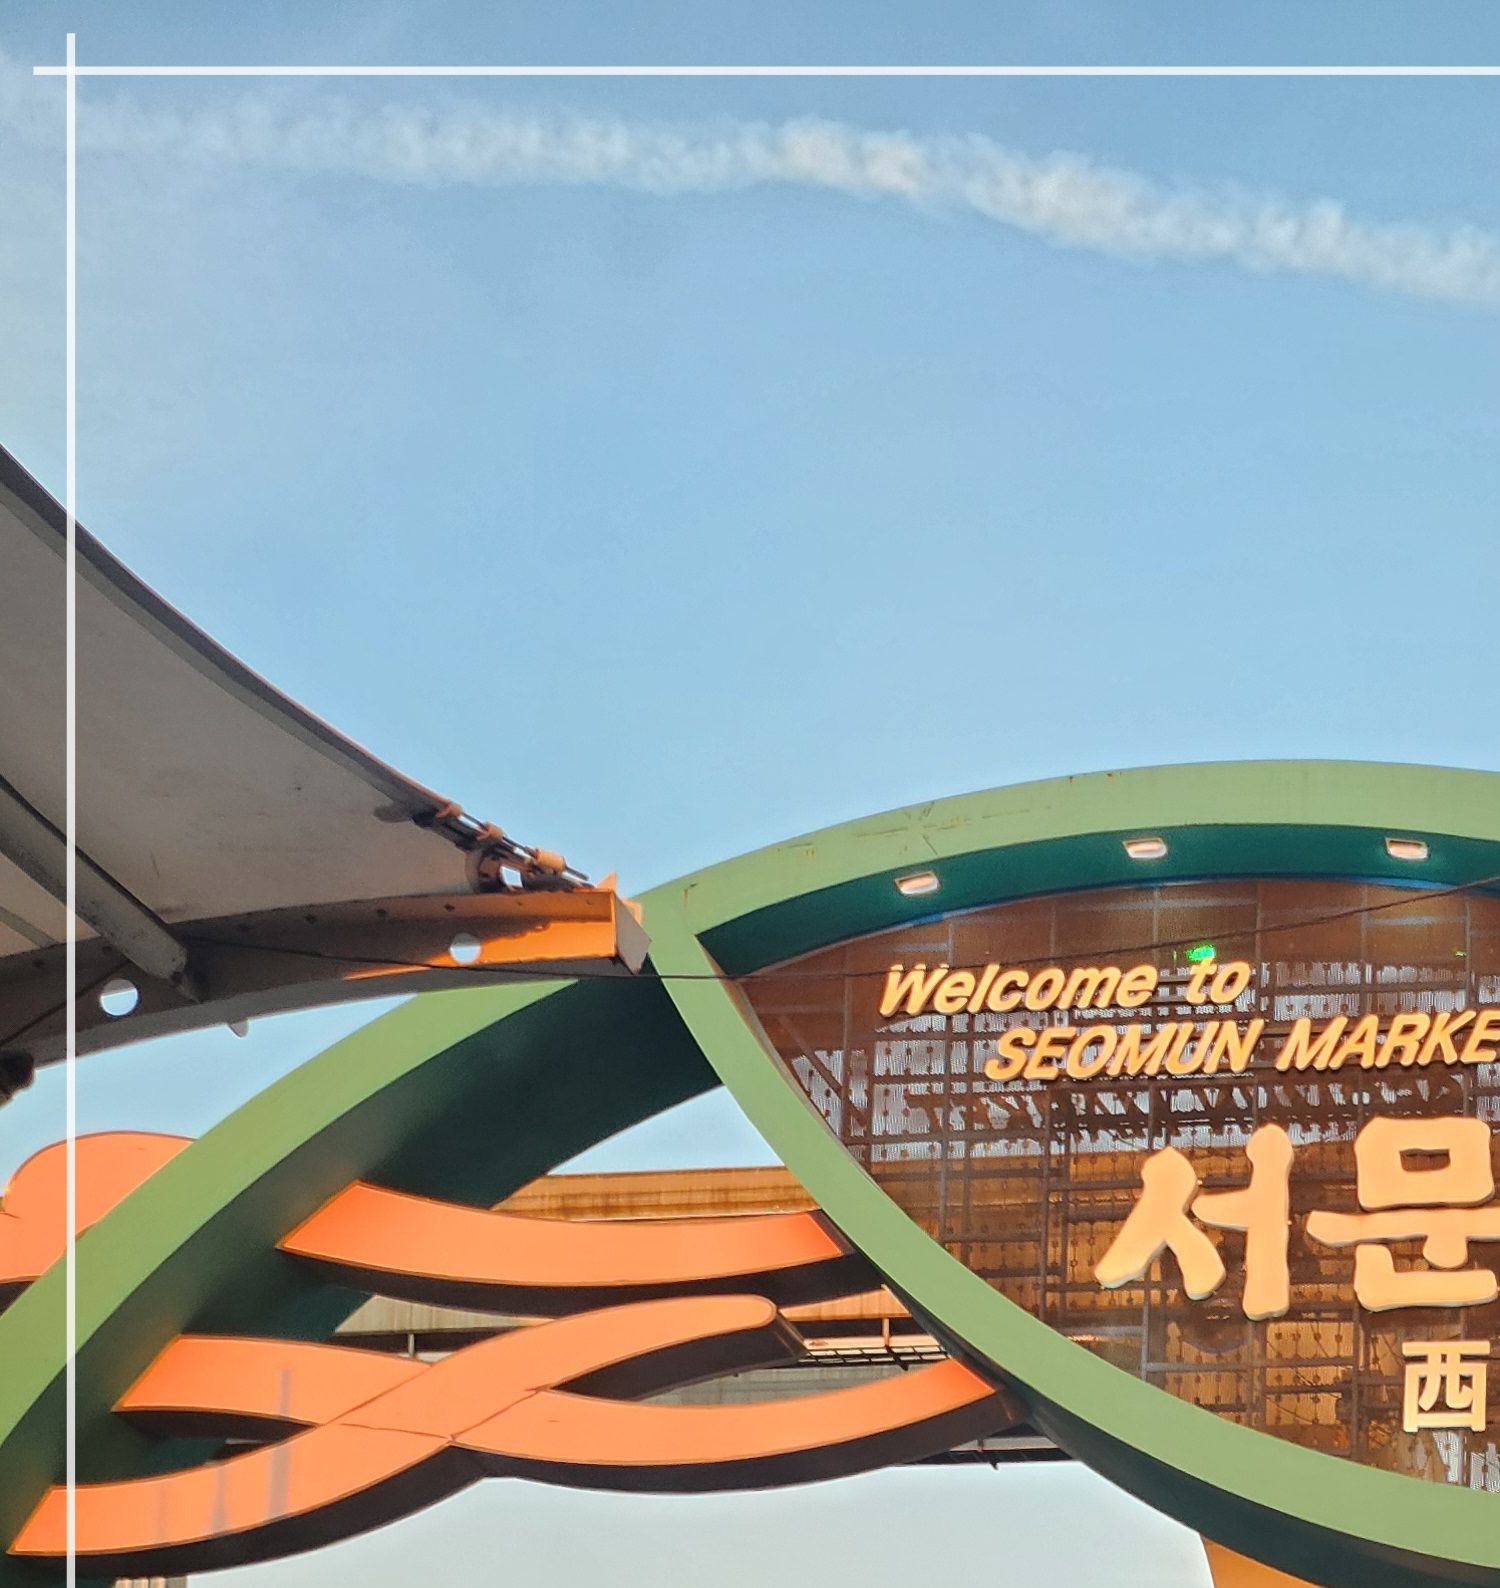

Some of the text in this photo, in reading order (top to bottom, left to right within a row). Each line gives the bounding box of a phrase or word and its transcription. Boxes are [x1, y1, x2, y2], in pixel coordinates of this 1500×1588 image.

[878, 957, 1251, 1018] Welcome to
[984, 1019, 1265, 1081] SEOMUN
